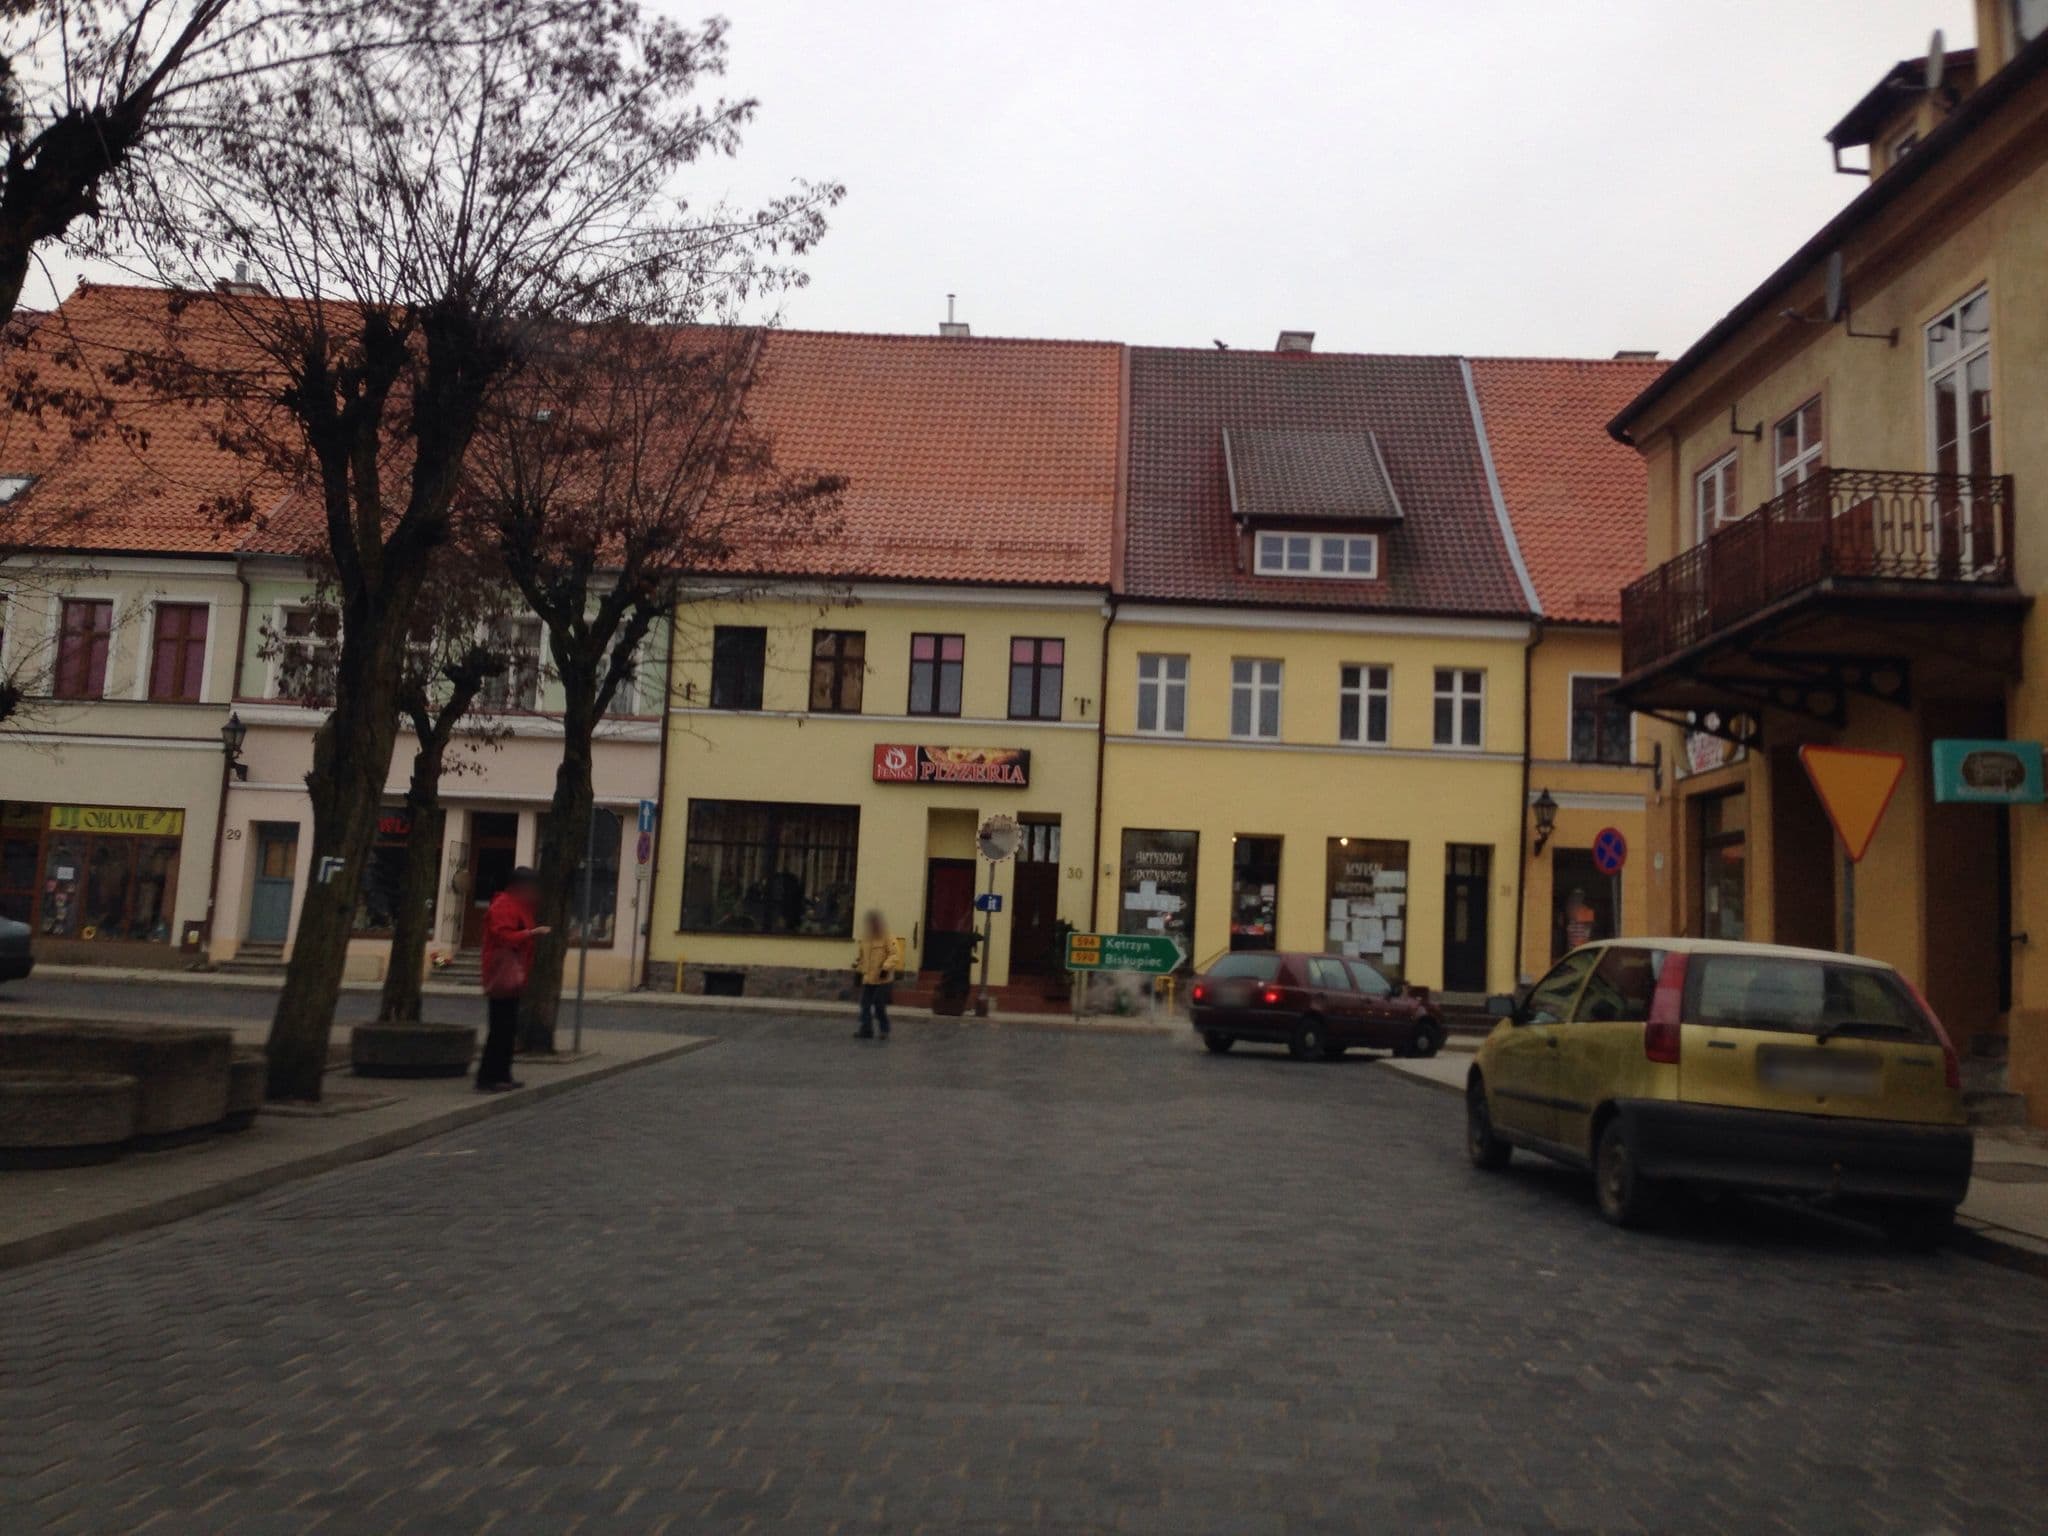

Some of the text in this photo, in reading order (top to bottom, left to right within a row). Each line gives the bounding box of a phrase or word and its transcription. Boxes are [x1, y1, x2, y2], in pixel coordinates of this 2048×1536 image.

[877, 762, 1026, 784] FENIKS PIZZERIA
[84, 811, 151, 830] OBUWIE
[225, 829, 241, 840] 29
[1066, 867, 1082, 880] 30
[1105, 938, 1151, 952] Kętrzyn
[1104, 953, 1163, 968] Biskupiec
